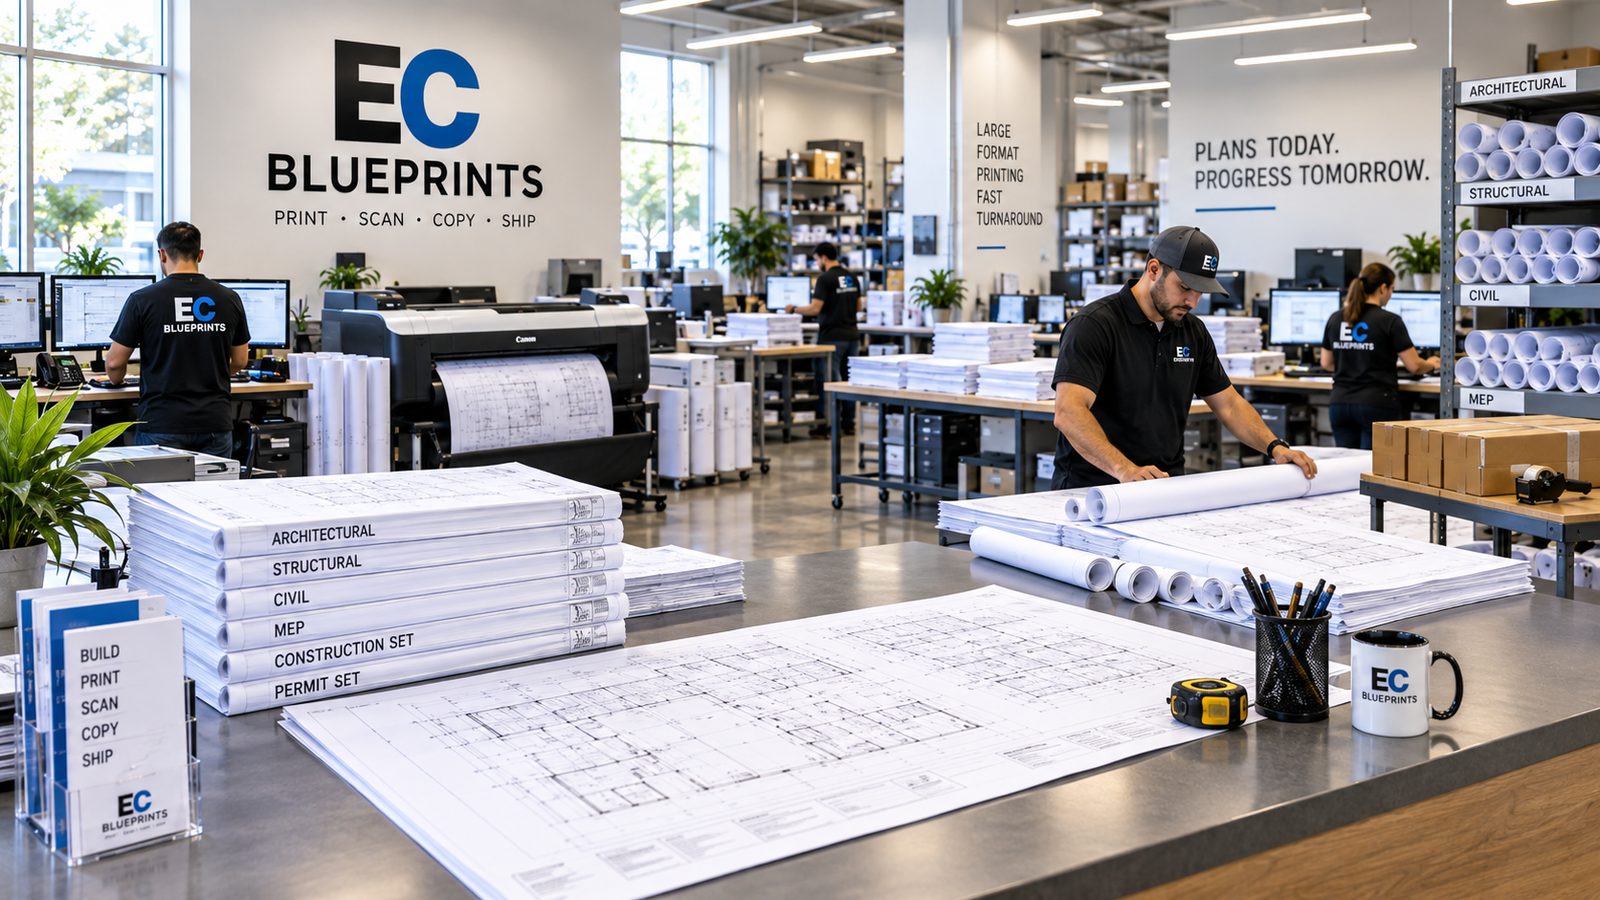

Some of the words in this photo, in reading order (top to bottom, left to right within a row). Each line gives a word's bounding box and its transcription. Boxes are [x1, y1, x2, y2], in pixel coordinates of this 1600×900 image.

[334, 39, 480, 149] EC
[1469, 77, 1567, 97] ARCHITECTURAL
[977, 122, 1011, 138] LARGE
[977, 144, 1019, 160] FORMAT
[1195, 138, 1257, 162] PLANS
[1267, 133, 1339, 158] TODAY.
[268, 153, 543, 199] BLUEPRINTS
[977, 167, 1024, 182] PRINTING
[1195, 166, 1292, 190] PROGRESS
[1299, 159, 1430, 186] TOMORROW.
[977, 189, 1002, 204] FAST
[1469, 185, 1550, 199] STRUCTURAL
[274, 210, 327, 226] PRINT
[359, 211, 404, 227] SCAN
[432, 212, 476, 227] COPY
[502, 214, 536, 228] SHIP
[977, 211, 1043, 226] TURNAROUND
[1469, 290, 1500, 301] CIVIL
[174, 296, 216, 322] EC
[163, 323, 226, 333] BLUEPRINTS
[1340, 321, 1369, 342] EC
[1176, 346, 1190, 357] EC
[1333, 342, 1375, 350] BLUEPRINTS
[1469, 393, 1494, 405] MEP
[272, 524, 375, 546] ARCHITECTURAL
[273, 554, 362, 577] STRUCTURAL
[274, 590, 310, 607] CIVIL
[274, 620, 305, 638] MEP
[80, 644, 120, 663] BUILD
[275, 638, 384, 668] CONSTRUCTION
[389, 633, 414, 649] SET
[81, 670, 120, 689] PRINT
[275, 677, 328, 699] PERMIT
[334, 671, 360, 688] SET
[1371, 666, 1409, 693] EC
[81, 696, 119, 715] SCAN
[1362, 691, 1418, 704] BLUEPRINTS
[81, 721, 119, 741] COPY
[82, 749, 113, 767] SHIP
[118, 789, 152, 817] EC
[102, 809, 168, 833] BLUEPRINTS
